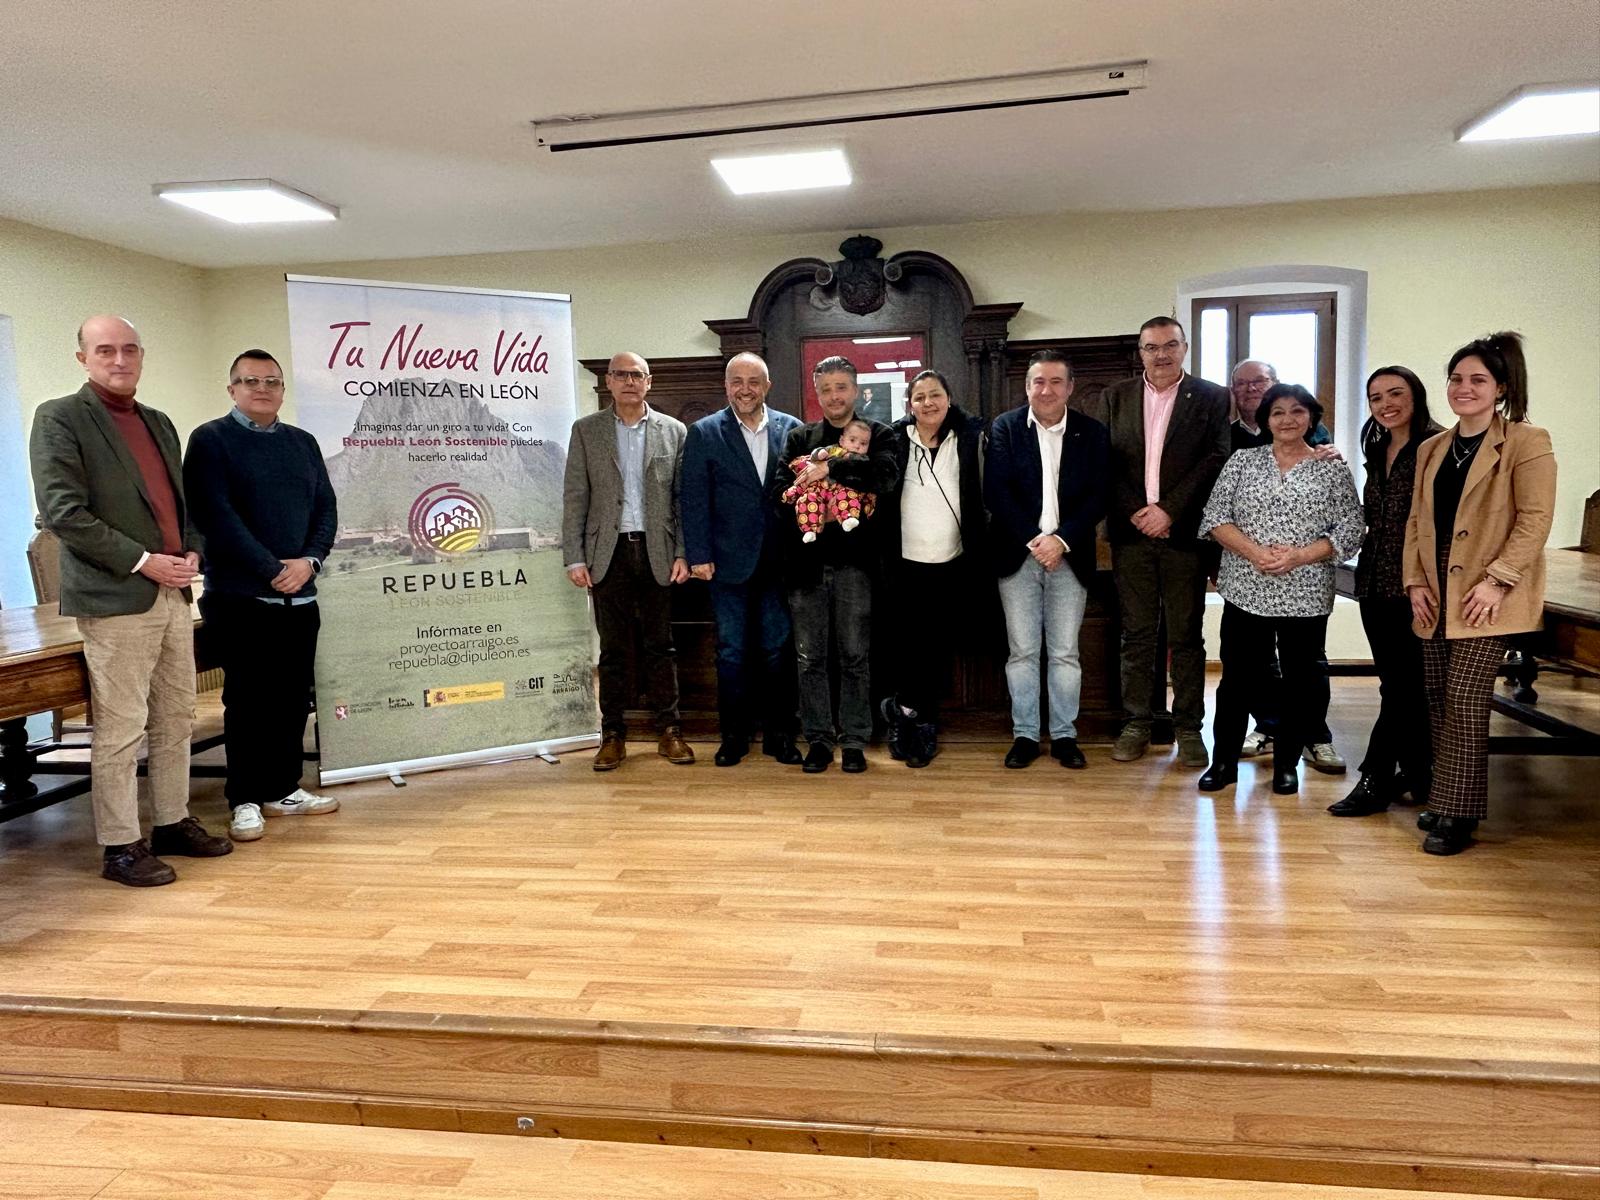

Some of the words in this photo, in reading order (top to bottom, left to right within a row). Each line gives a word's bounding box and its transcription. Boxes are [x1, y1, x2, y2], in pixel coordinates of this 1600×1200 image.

[328, 321, 371, 369] Tu
[380, 323, 479, 372] Nueva
[493, 329, 549, 376] Vida
[344, 380, 454, 398] COMIENZA
[460, 383, 483, 399] EN
[491, 381, 538, 400] LEÓN
[353, 422, 402, 434] ¿Imaginas
[405, 422, 423, 432] dar
[426, 424, 440, 432] un
[442, 423, 462, 434] giro
[473, 424, 484, 432] tu
[486, 422, 509, 432] vida?
[512, 423, 532, 432] Con
[342, 437, 405, 449] Repuebla
[409, 437, 441, 447] León
[445, 437, 508, 447] Sostenible
[510, 438, 543, 449] puedes
[408, 452, 447, 462] hacerlo
[450, 452, 488, 462] realidad
[382, 568, 528, 594] REPUEBLA
[417, 625, 482, 639] Infórmate
[487, 623, 502, 633] en
[400, 635, 519, 658] proyectoarraigo.es
[388, 648, 531, 672] repuebla@dipuleon.es
[528, 677, 545, 689] CIT
